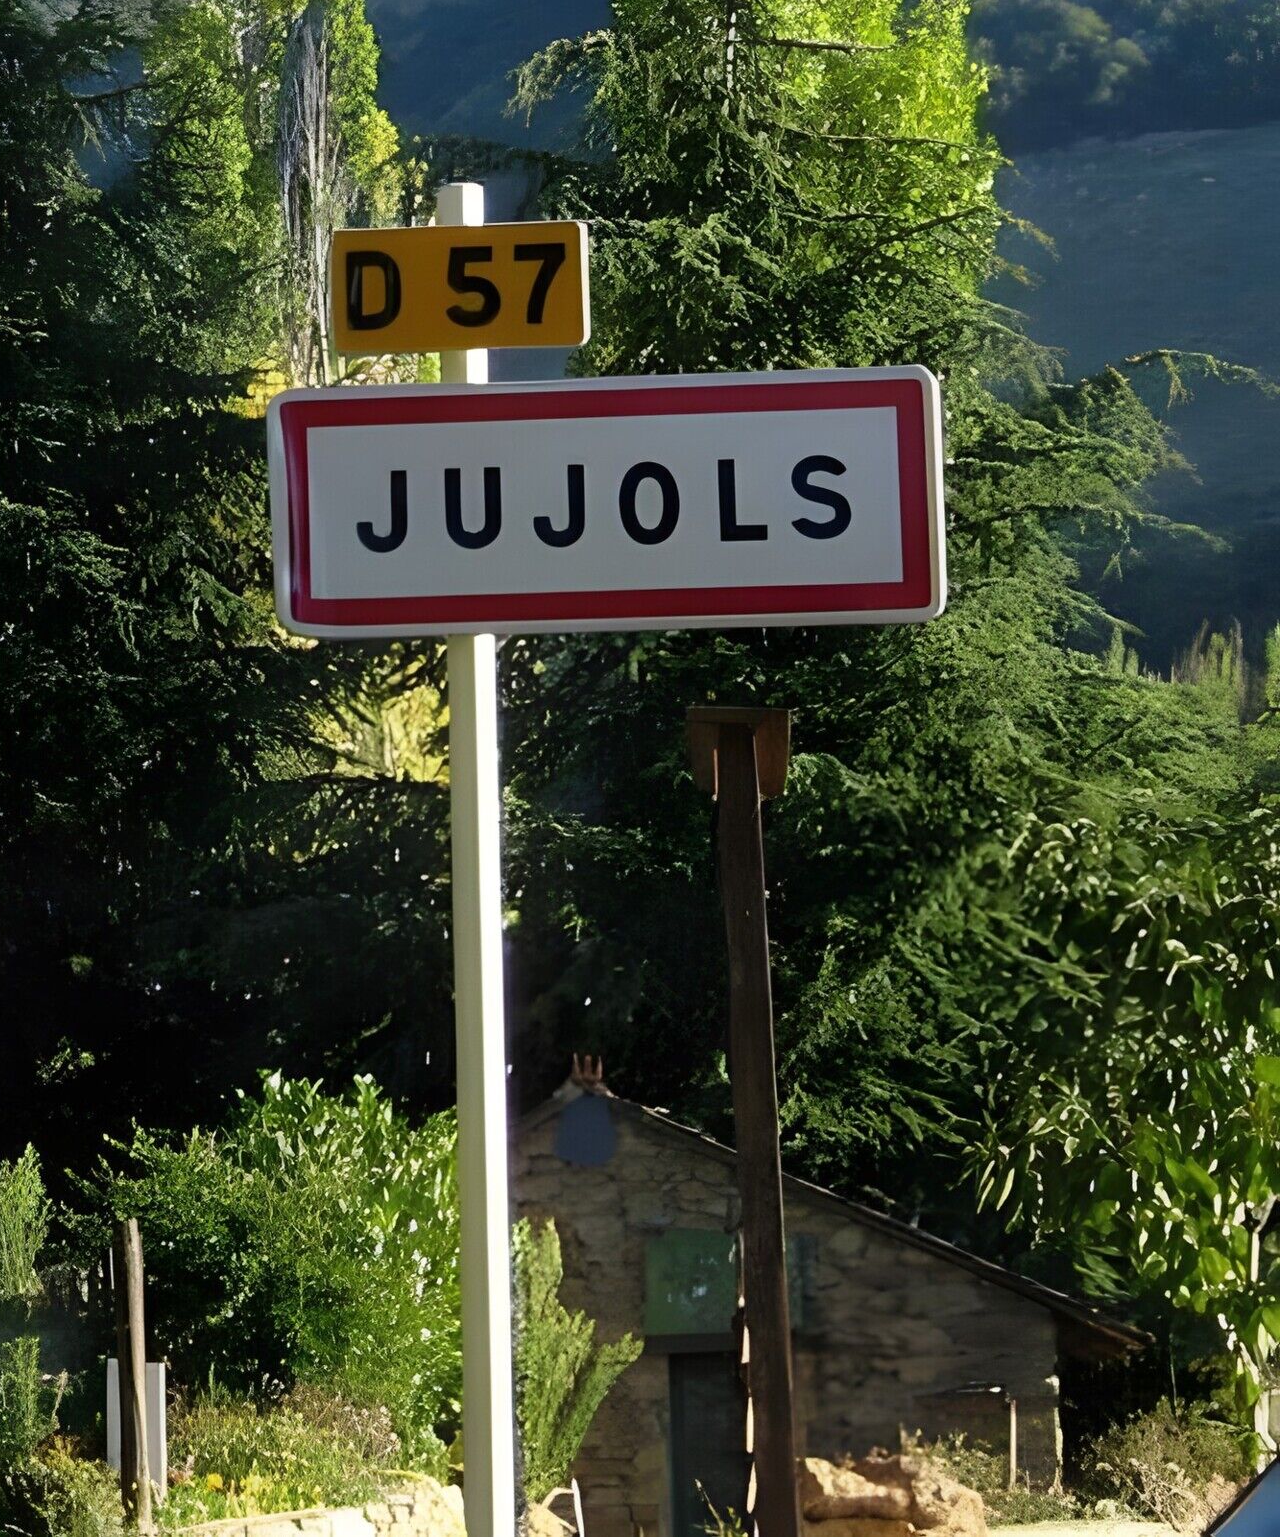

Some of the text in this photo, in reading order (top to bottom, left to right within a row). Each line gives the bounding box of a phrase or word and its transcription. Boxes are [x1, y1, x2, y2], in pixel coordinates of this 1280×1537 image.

[344, 243, 567, 330] D 57
[356, 455, 852, 552] JUJOLS
